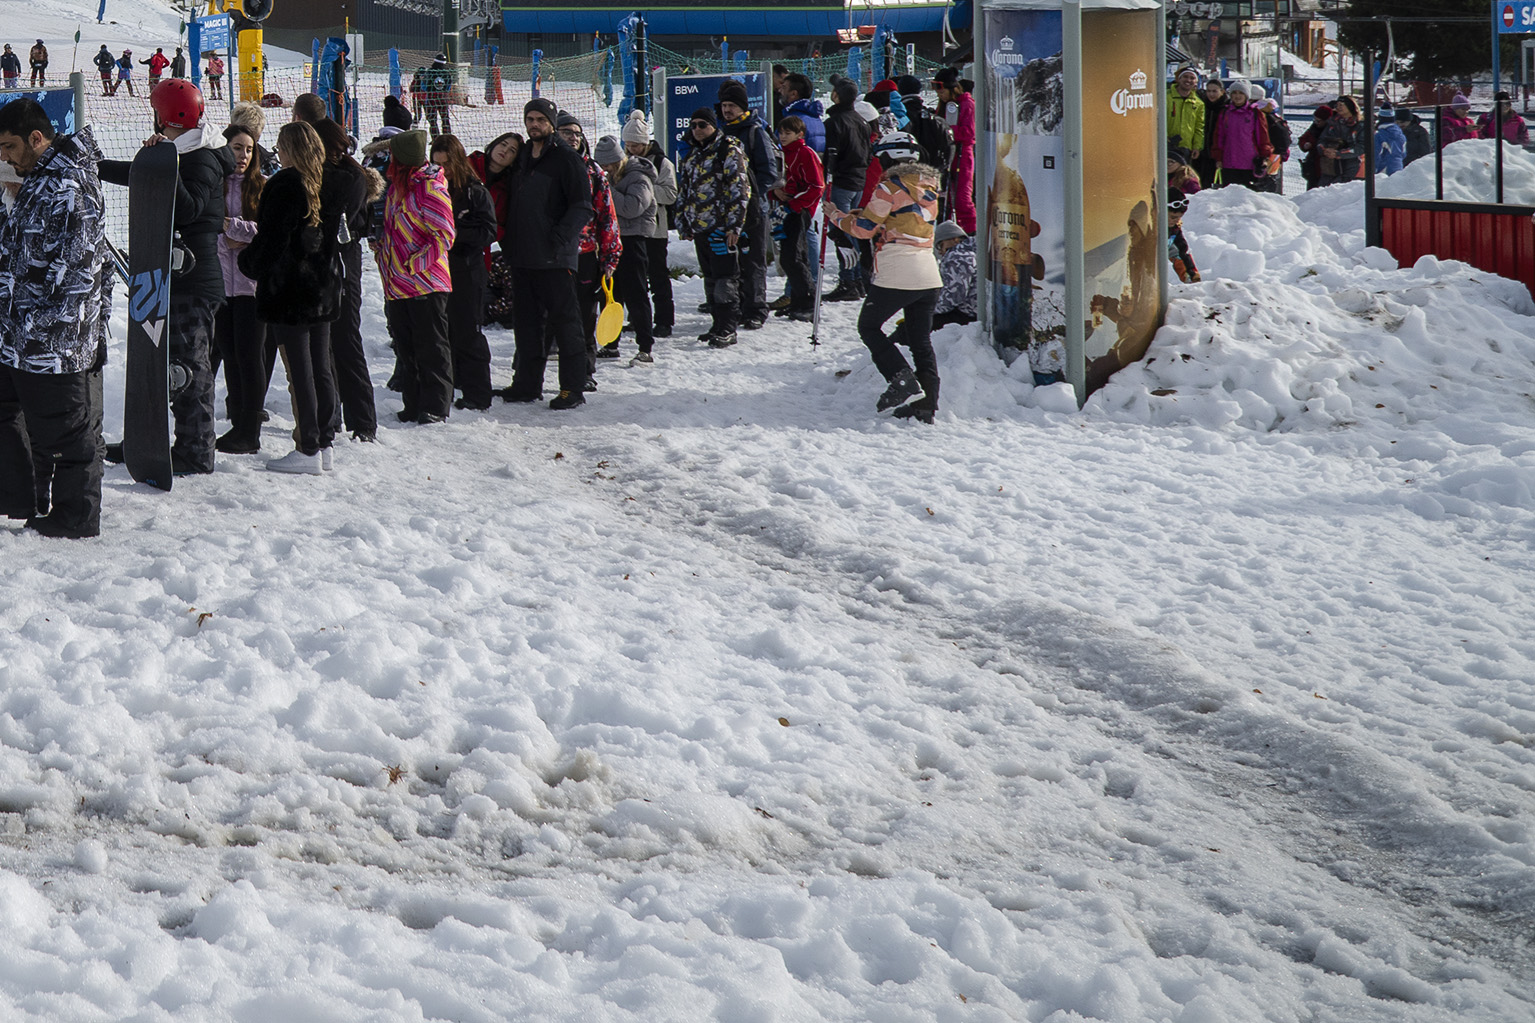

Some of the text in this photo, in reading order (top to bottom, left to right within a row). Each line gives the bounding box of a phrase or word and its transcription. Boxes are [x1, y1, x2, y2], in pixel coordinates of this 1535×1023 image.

[204, 18, 222, 29] MAGIC
[991, 48, 1024, 67] Corona
[674, 85, 699, 95] BBVA
[992, 205, 1027, 231] Corona
